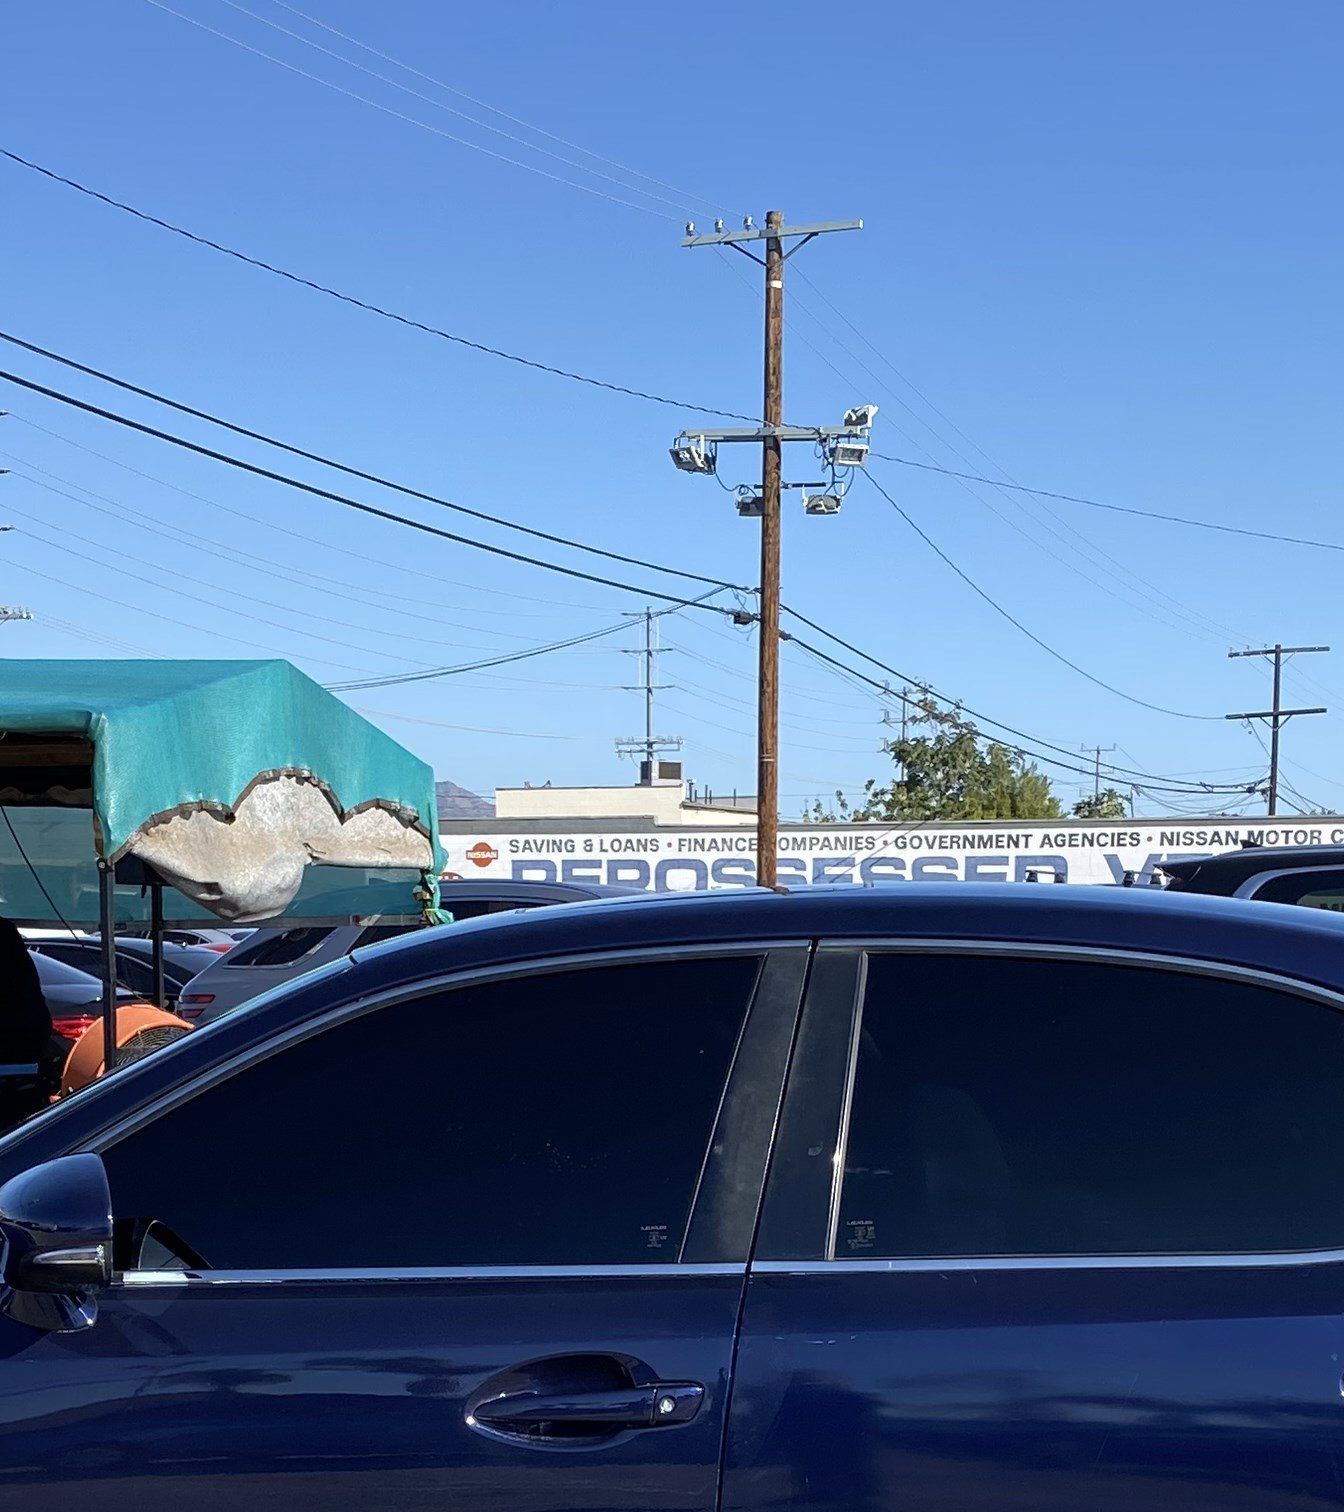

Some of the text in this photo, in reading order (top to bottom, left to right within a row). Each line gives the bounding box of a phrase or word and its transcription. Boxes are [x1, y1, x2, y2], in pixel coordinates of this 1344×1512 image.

[509, 839, 576, 853] SAVING
[583, 838, 592, 853] &
[600, 837, 660, 853] LOANS
[678, 836, 757, 852] FINANCE
[778, 835, 876, 851] OMPANIES
[894, 832, 1033, 850] GOVERNMENT
[1040, 831, 1141, 848] AGENCIES
[1160, 829, 1239, 846] NISSAN
[1247, 828, 1322, 845] MOTOR
